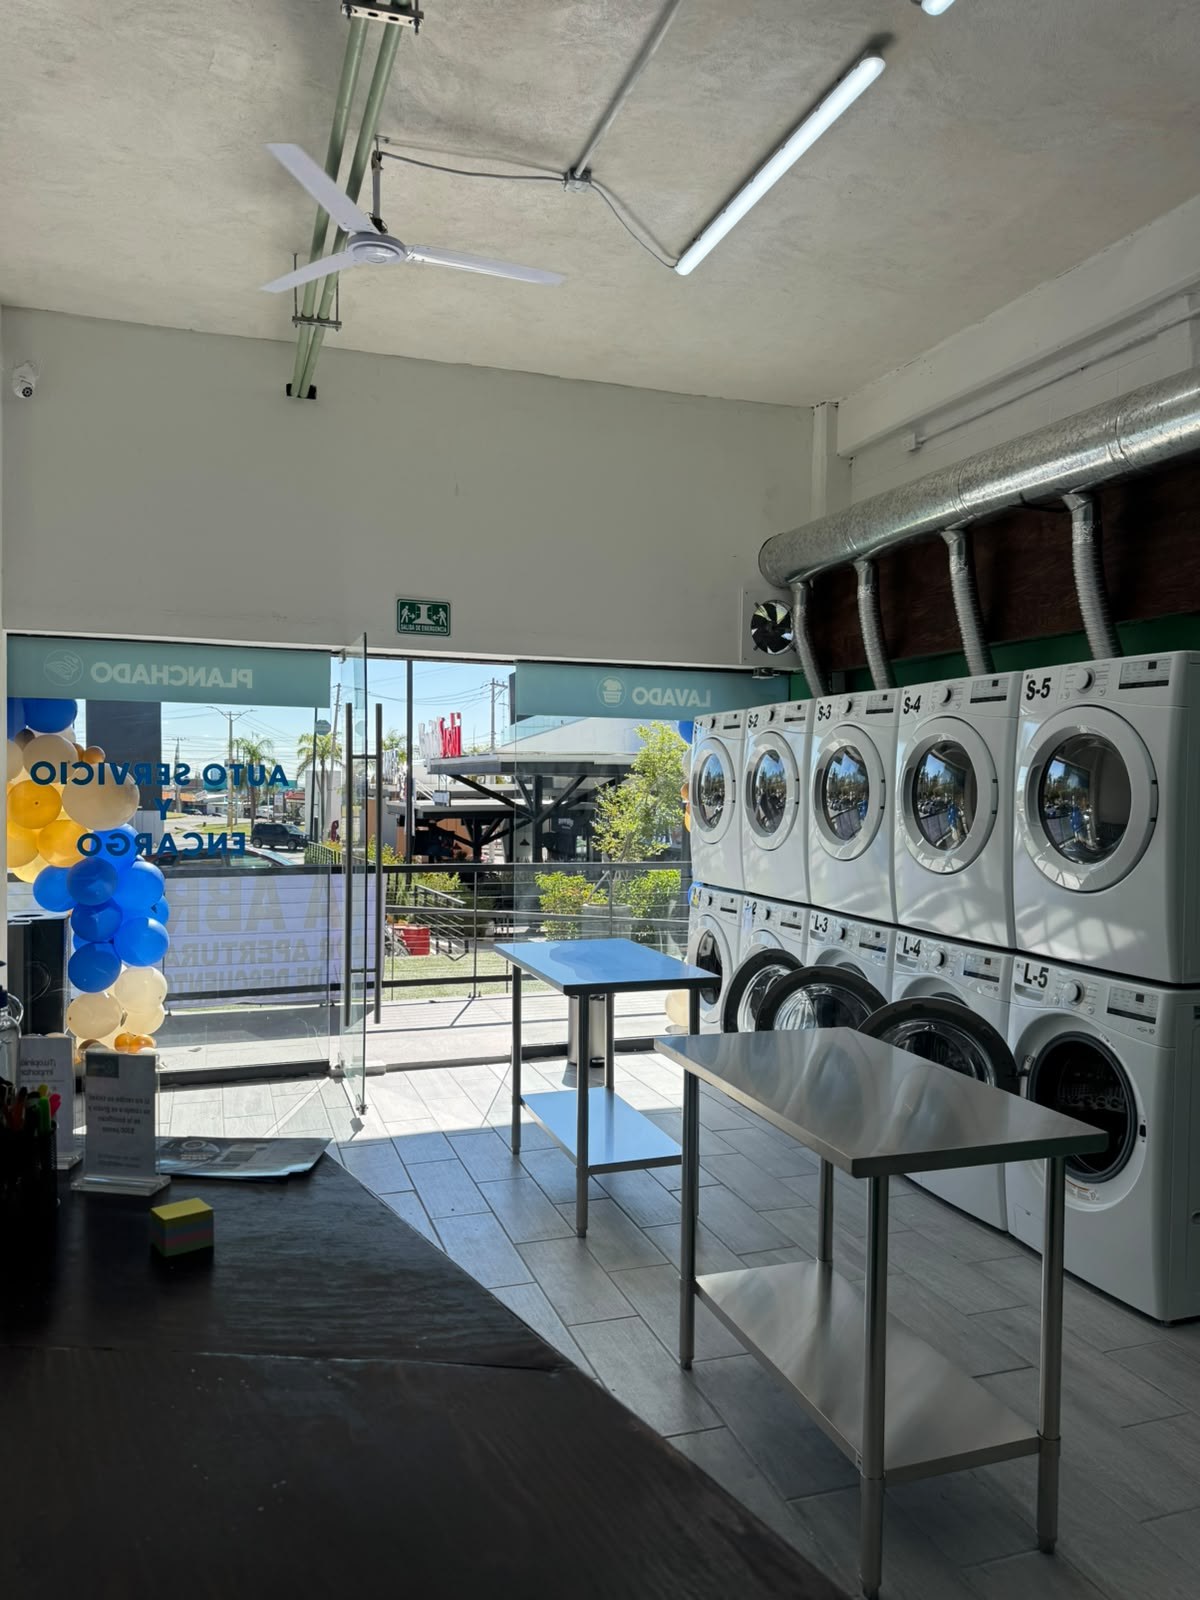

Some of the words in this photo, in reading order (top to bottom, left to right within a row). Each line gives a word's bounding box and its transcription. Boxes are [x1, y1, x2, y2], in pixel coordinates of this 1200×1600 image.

[1026, 677, 1051, 701] S-5
[817, 704, 832, 721] S-3
[903, 695, 921, 714] S-4
[747, 713, 759, 728] S-2
[814, 914, 828, 932] L-3
[902, 936, 921, 957] L-4
[1023, 963, 1049, 988] L-5
